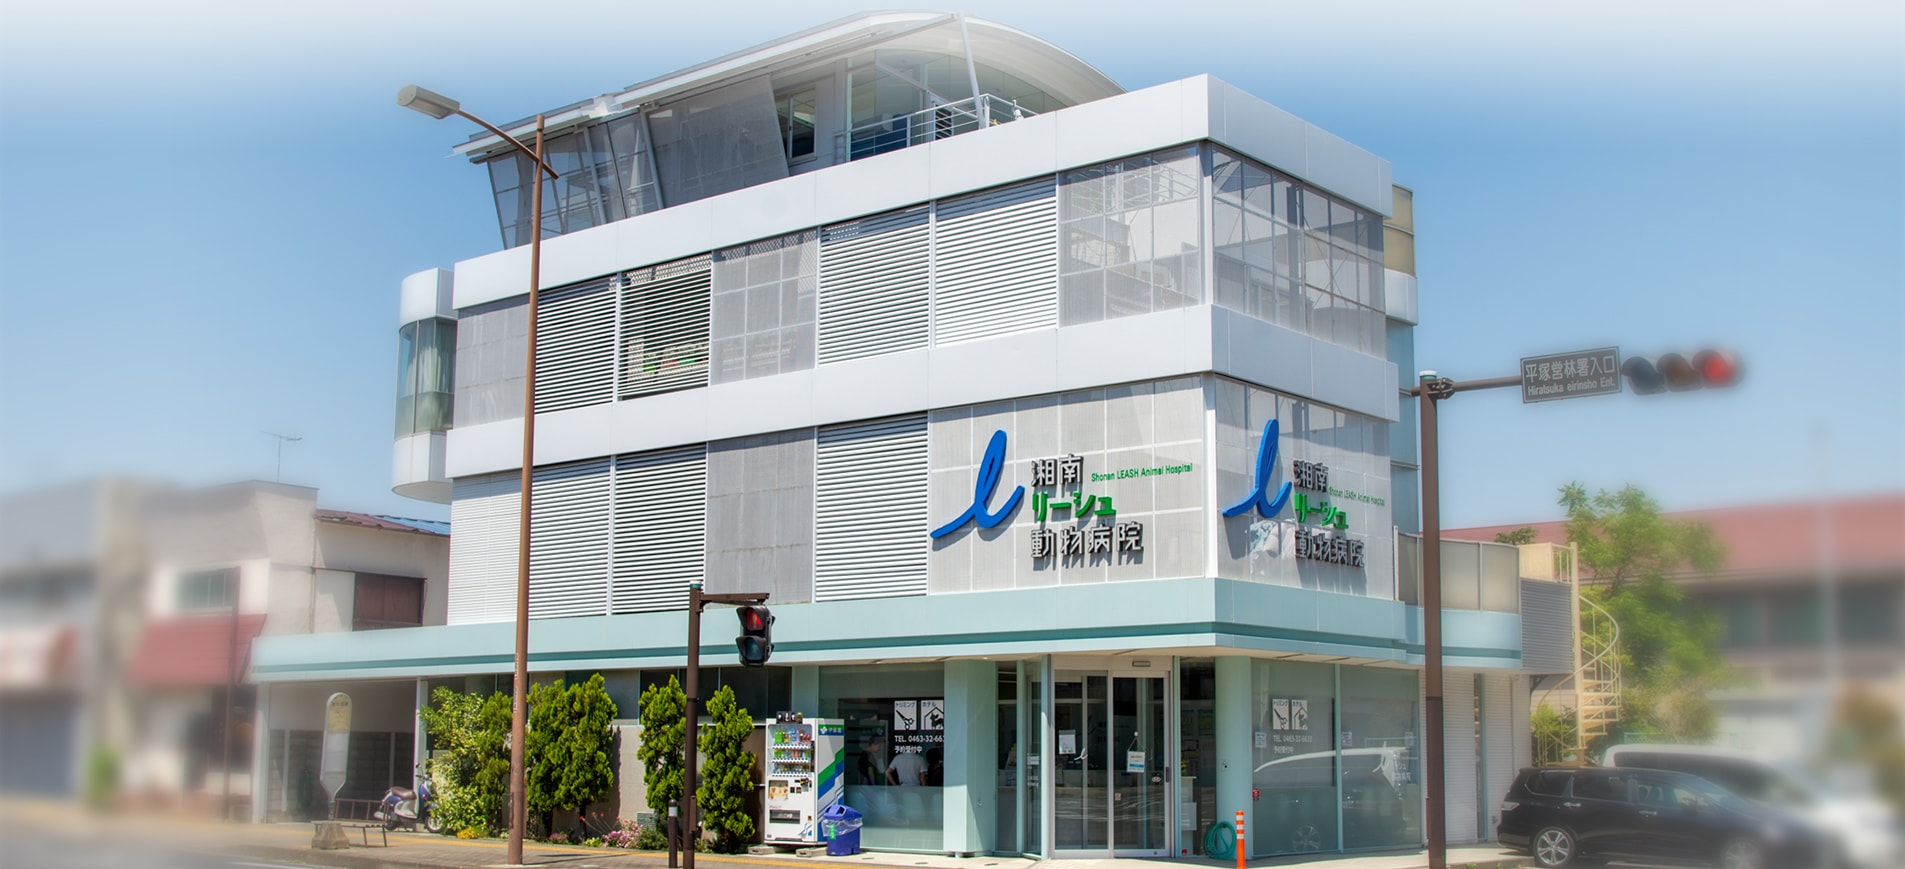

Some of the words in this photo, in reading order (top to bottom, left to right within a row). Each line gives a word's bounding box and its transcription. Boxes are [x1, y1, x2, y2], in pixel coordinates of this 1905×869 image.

[1525, 355, 1615, 383] 平塚営林署入口
[1528, 382, 1564, 396] Hiratsuka
[1567, 379, 1598, 392] eirinsho
[1600, 376, 1616, 388] Ent.
[1031, 453, 1083, 487] 湘南
[1091, 472, 1115, 482] Shonan
[1117, 468, 1139, 479] LEASH
[1141, 465, 1164, 477] Animal
[1165, 463, 1193, 475] Hospital
[1293, 460, 1329, 493] 湘南
[1032, 492, 1116, 522] リーシュ
[1294, 493, 1349, 529] リーシュ
[1031, 521, 1144, 558] 動物病院
[1295, 529, 1364, 567] 動物病院
